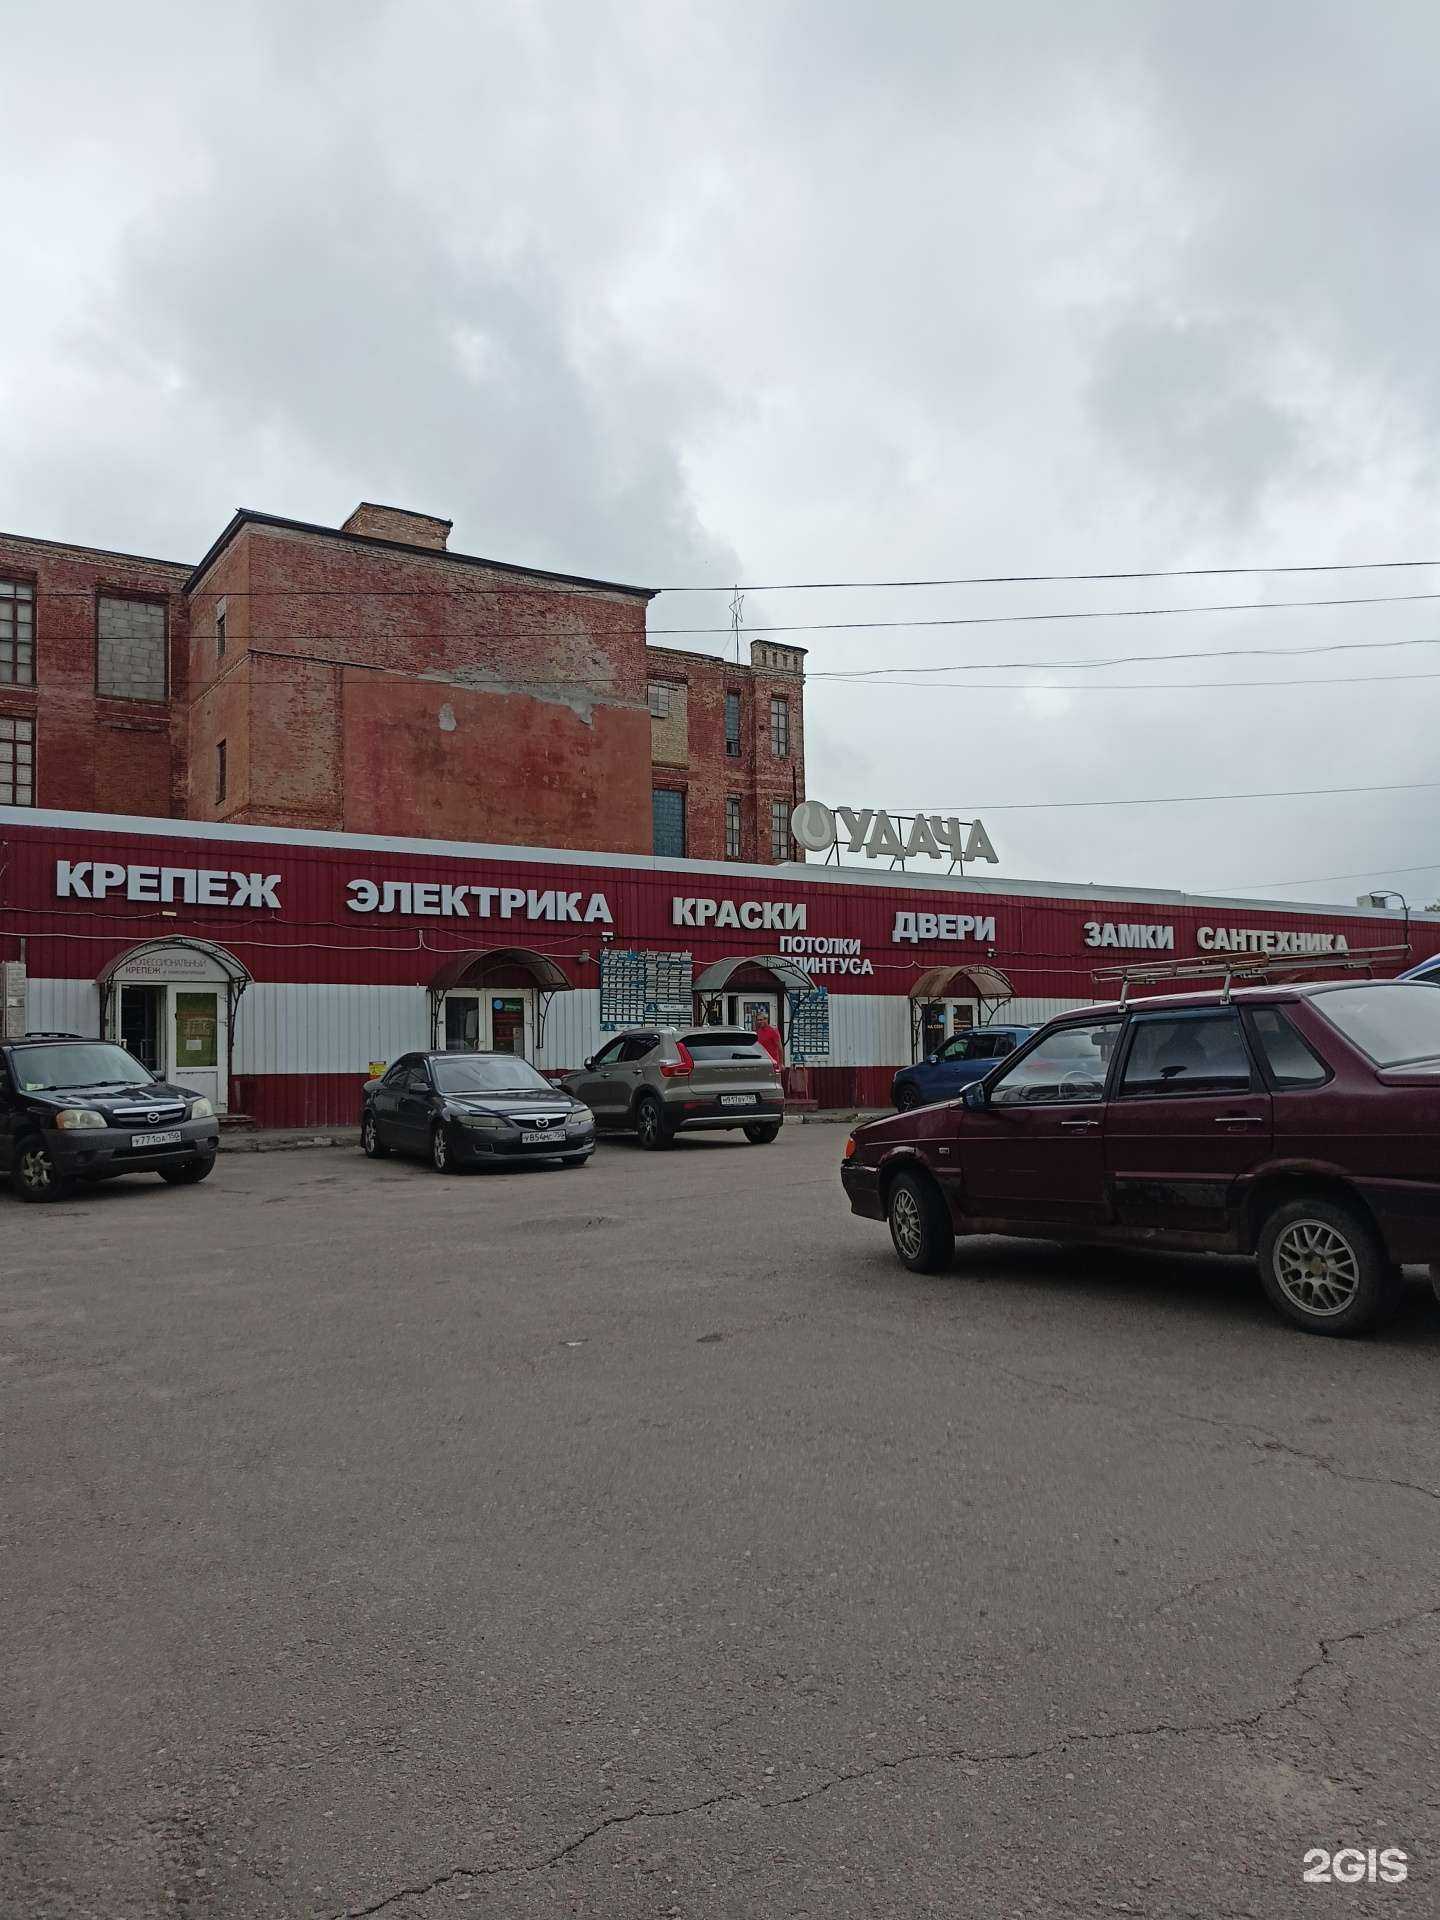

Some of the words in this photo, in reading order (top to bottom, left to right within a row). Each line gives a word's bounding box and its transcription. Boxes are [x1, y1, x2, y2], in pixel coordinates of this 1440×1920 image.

[837, 806, 999, 863] УДАЧА
[56, 860, 282, 908] КРЕПЕЖ
[345, 879, 614, 923] ЭЛЕКТРИКА
[672, 897, 807, 930] КРАСКИ
[892, 911, 996, 943] ДВЕРИ
[1084, 921, 1174, 949] ЗАМКИ
[1197, 926, 1349, 951] САНТЕХНИКА
[779, 936, 861, 955] ПОТОЛКИ
